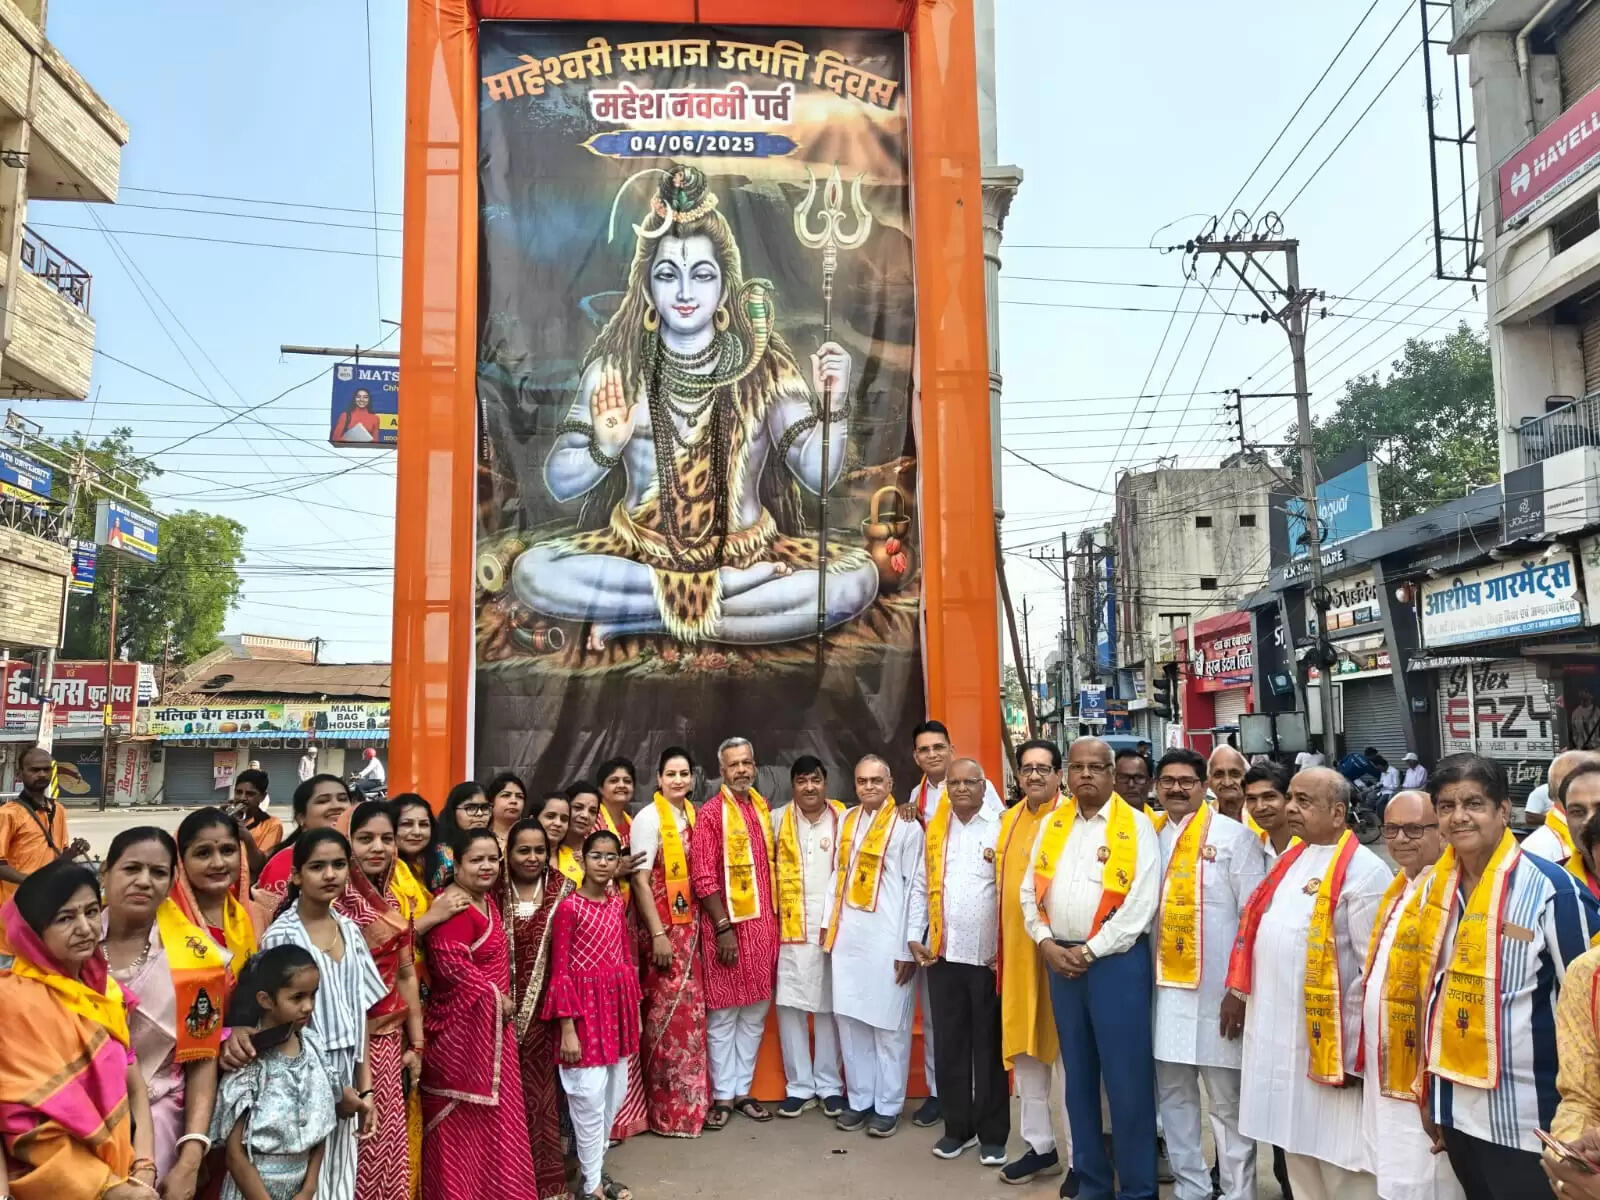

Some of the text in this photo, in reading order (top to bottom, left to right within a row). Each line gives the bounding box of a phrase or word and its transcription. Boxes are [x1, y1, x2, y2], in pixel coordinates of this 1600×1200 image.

[482, 37, 898, 109] माहेश्वरी समाज उत्पत्ति दिवस
[592, 85, 792, 121] महेश नवमी पर्व
[630, 136, 755, 152] 04/06/2025
[358, 369, 400, 381] MATS
[1425, 577, 1481, 616] आशीष
[88, 684, 132, 709] फुटयर
[155, 707, 197, 721] मलिक
[331, 704, 364, 712] MALIK
[336, 712, 358, 721] BAG
[329, 721, 366, 729] HOUSE
